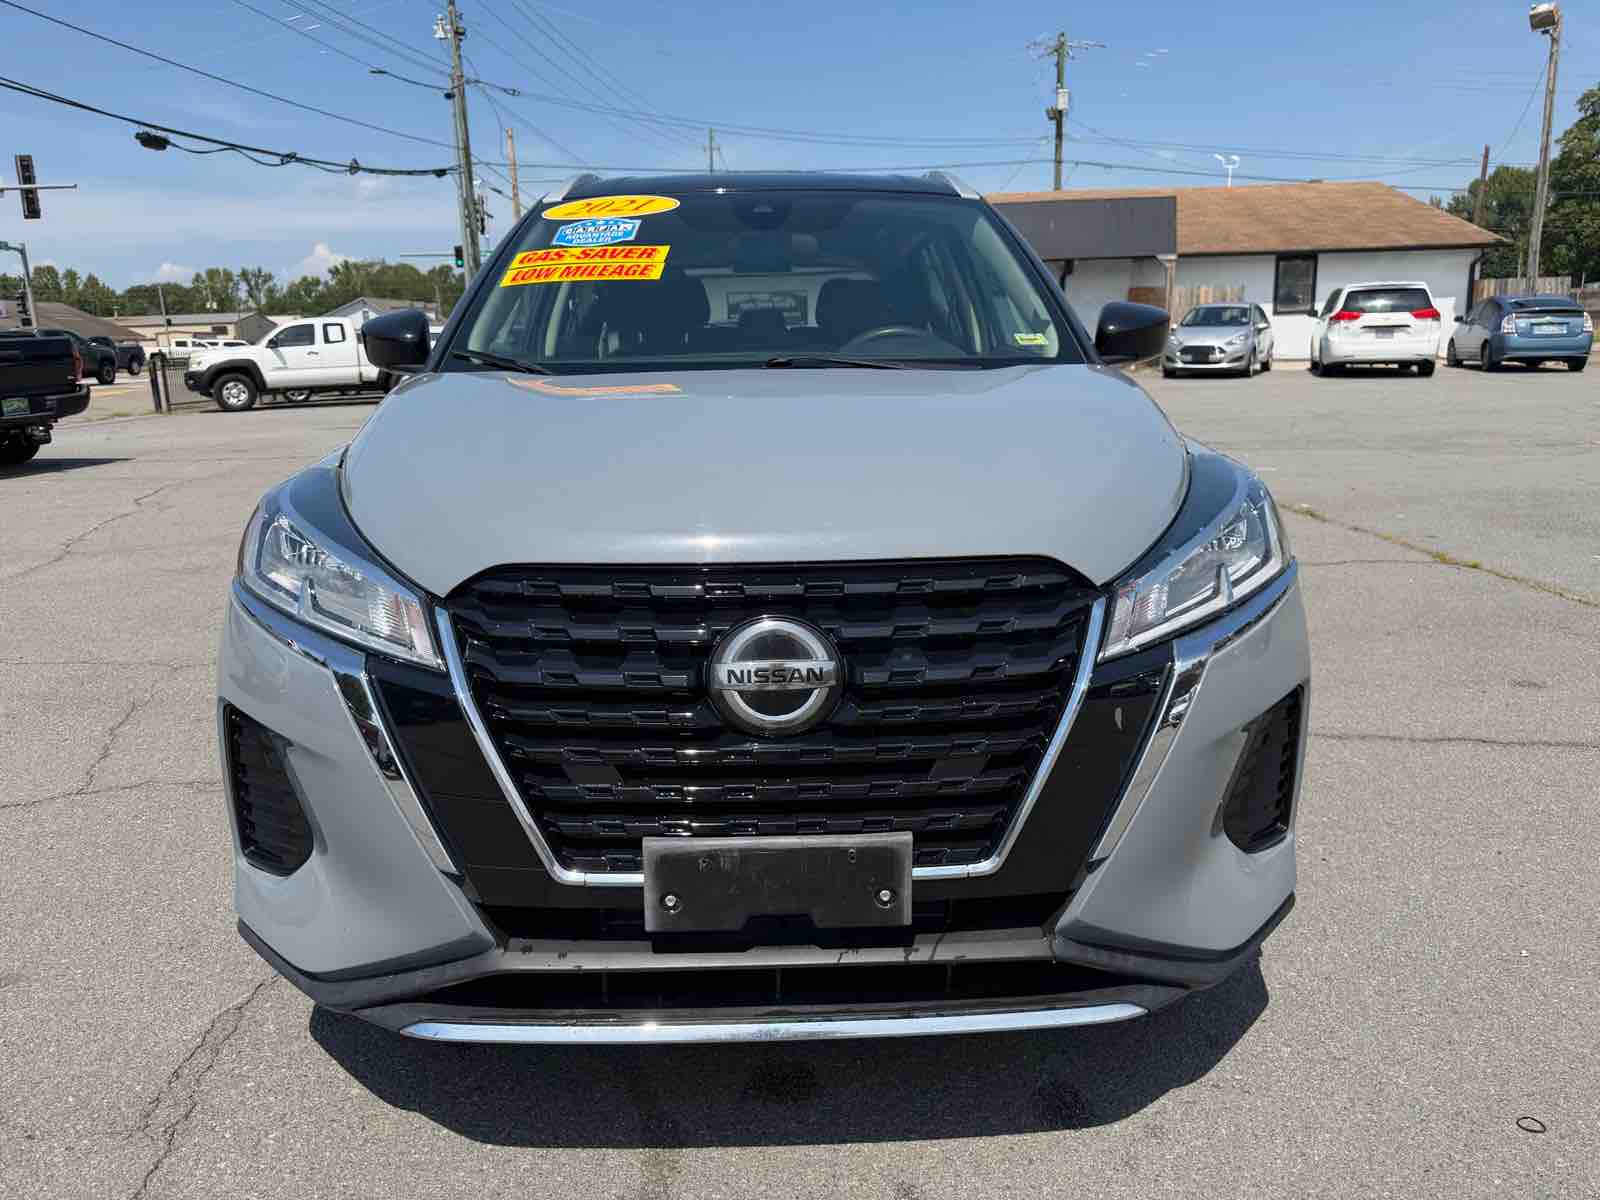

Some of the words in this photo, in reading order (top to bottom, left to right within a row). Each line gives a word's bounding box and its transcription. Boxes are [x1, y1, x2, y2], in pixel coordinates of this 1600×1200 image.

[564, 198, 657, 216] 2021
[510, 266, 557, 282] LOW
[559, 264, 654, 278] MILEAGE
[727, 667, 823, 683] NISSAN
